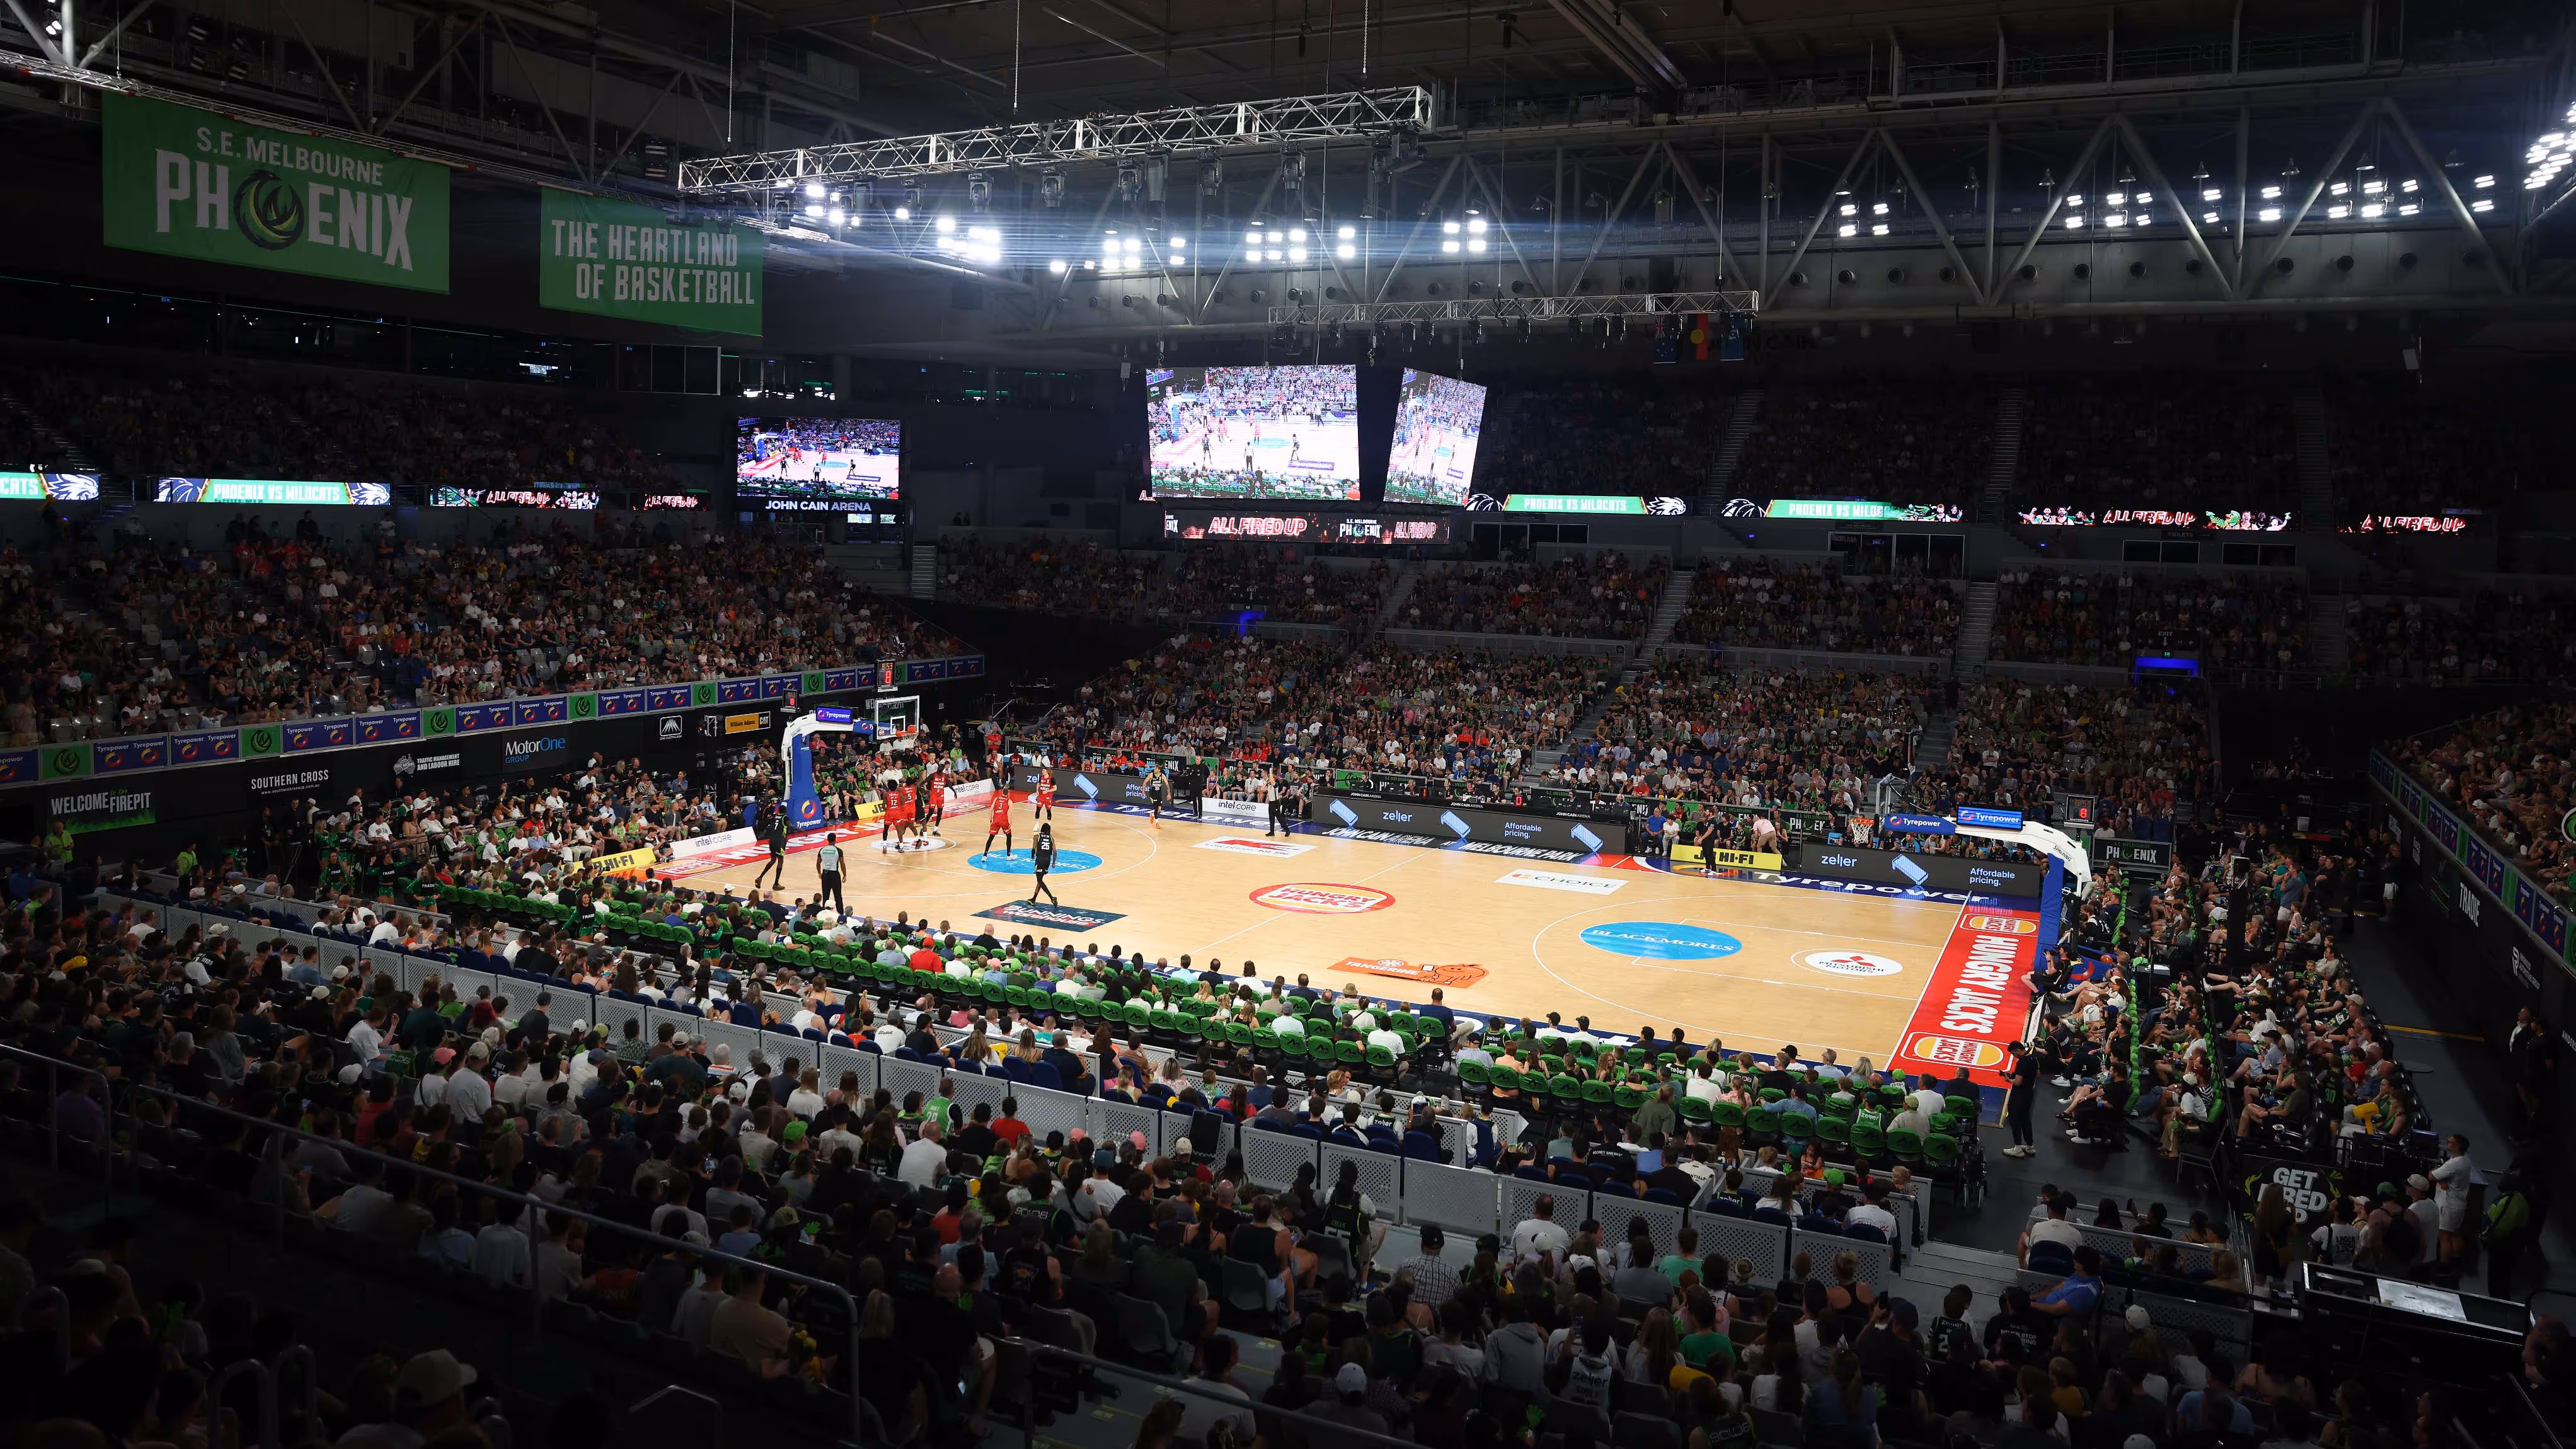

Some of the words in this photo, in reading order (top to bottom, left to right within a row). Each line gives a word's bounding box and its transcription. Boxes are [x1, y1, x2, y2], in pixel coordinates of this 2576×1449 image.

[197, 127, 241, 158] S.E.
[246, 134, 383, 186] MELBOURNE
[156, 148, 413, 271] PHOENIX
[552, 219, 598, 259] THE
[607, 225, 738, 266] HEARTLAND
[575, 263, 604, 300] OF
[613, 264, 755, 304] BASKETBALL
[214, 484, 264, 499] PHOENIX
[268, 485, 282, 500] VS
[285, 485, 340, 501] WILDCATS
[766, 500, 798, 511] JOHN
[800, 501, 828, 511] CAIN
[831, 502, 871, 511] ARENA
[1524, 498, 1563, 510] PHOENIX
[1567, 499, 1578, 510] VS
[1580, 499, 1627, 511] WILDCATS
[1790, 503, 1832, 516] PHOENIX
[1836, 504, 1849, 516] VS
[2103, 510, 2130, 523] ALL
[2131, 511, 2174, 524] FIRED
[2175, 511, 2197, 525] UP
[1208, 517, 1238, 534] ALL
[1237, 517, 1284, 535] FIRED
[1283, 518, 1307, 536] UP
[1340, 523, 1381, 538] PHOENIX
[1394, 522, 1408, 538] ALL
[1407, 522, 1427, 538] FIRED
[1425, 522, 1437, 538] UP
[2441, 517, 2466, 533] UP
[885, 671, 892, 684] 8
[759, 716, 769, 725] CAT
[825, 711, 850, 719] Tyrepower
[134, 741, 164, 749] Tyrepower
[175, 736, 204, 745] Tyrepower
[505, 737, 565, 756] MotorOne
[97, 744, 129, 753] Tyrepower
[433, 753, 460, 762] MANAGEMENT
[505, 754, 529, 764] GROUP
[428, 761, 447, 770] LABOUR
[448, 759, 460, 767] HIRE
[251, 773, 298, 790] SOUTHERN
[301, 770, 329, 783] CROSS
[51, 792, 109, 815] WELCOME
[110, 792, 151, 813] FIREPIT
[1219, 800, 1235, 809] intel
[1383, 810, 1413, 822] zeller
[1975, 812, 2020, 823] Tyrepower
[2079, 807, 2088, 819] 8
[774, 822, 779, 830] 7
[796, 819, 822, 828] Tyrepower
[1505, 822, 1542, 832] Affordable
[1903, 818, 1941, 828] Tyrepower
[1504, 829, 1531, 839] pricing.
[695, 836, 712, 847] intel
[1041, 841, 1050, 850] 25
[1322, 827, 1359, 838] JOHN
[1356, 829, 1393, 841] CAIN
[1459, 841, 1544, 858] MELBOURNE
[1540, 850, 1585, 862] PARK
[2053, 845, 2072, 862] SPALDING
[2107, 845, 2157, 864] PHOENIX
[1821, 853, 1857, 868] zeller
[1970, 868, 2015, 879] Affordable
[1534, 874, 1618, 889] CHOICE
[1754, 872, 1989, 903] Tyrepower
[1970, 876, 2002, 886] pricing.
[1280, 888, 1377, 902] HUNGRY
[2460, 882, 2480, 928] TRADIE
[1006, 904, 1106, 925] BUNNINGS
[1592, 929, 1735, 951] BLACKMORES
[1345, 961, 1421, 976] TANGERINE
[1818, 960, 1886, 973] MITSUBISHI
[1958, 934, 2020, 991] HUNGRY
[1826, 965, 1874, 974] MOTORS
[1958, 1042, 1979, 1064] HUNGRY
[1374, 1119, 1393, 1127] zeller
[1861, 1112, 1879, 1121] zeller
[2273, 1167, 2320, 1190] GET
[1572, 1370, 1609, 1387] zeller
